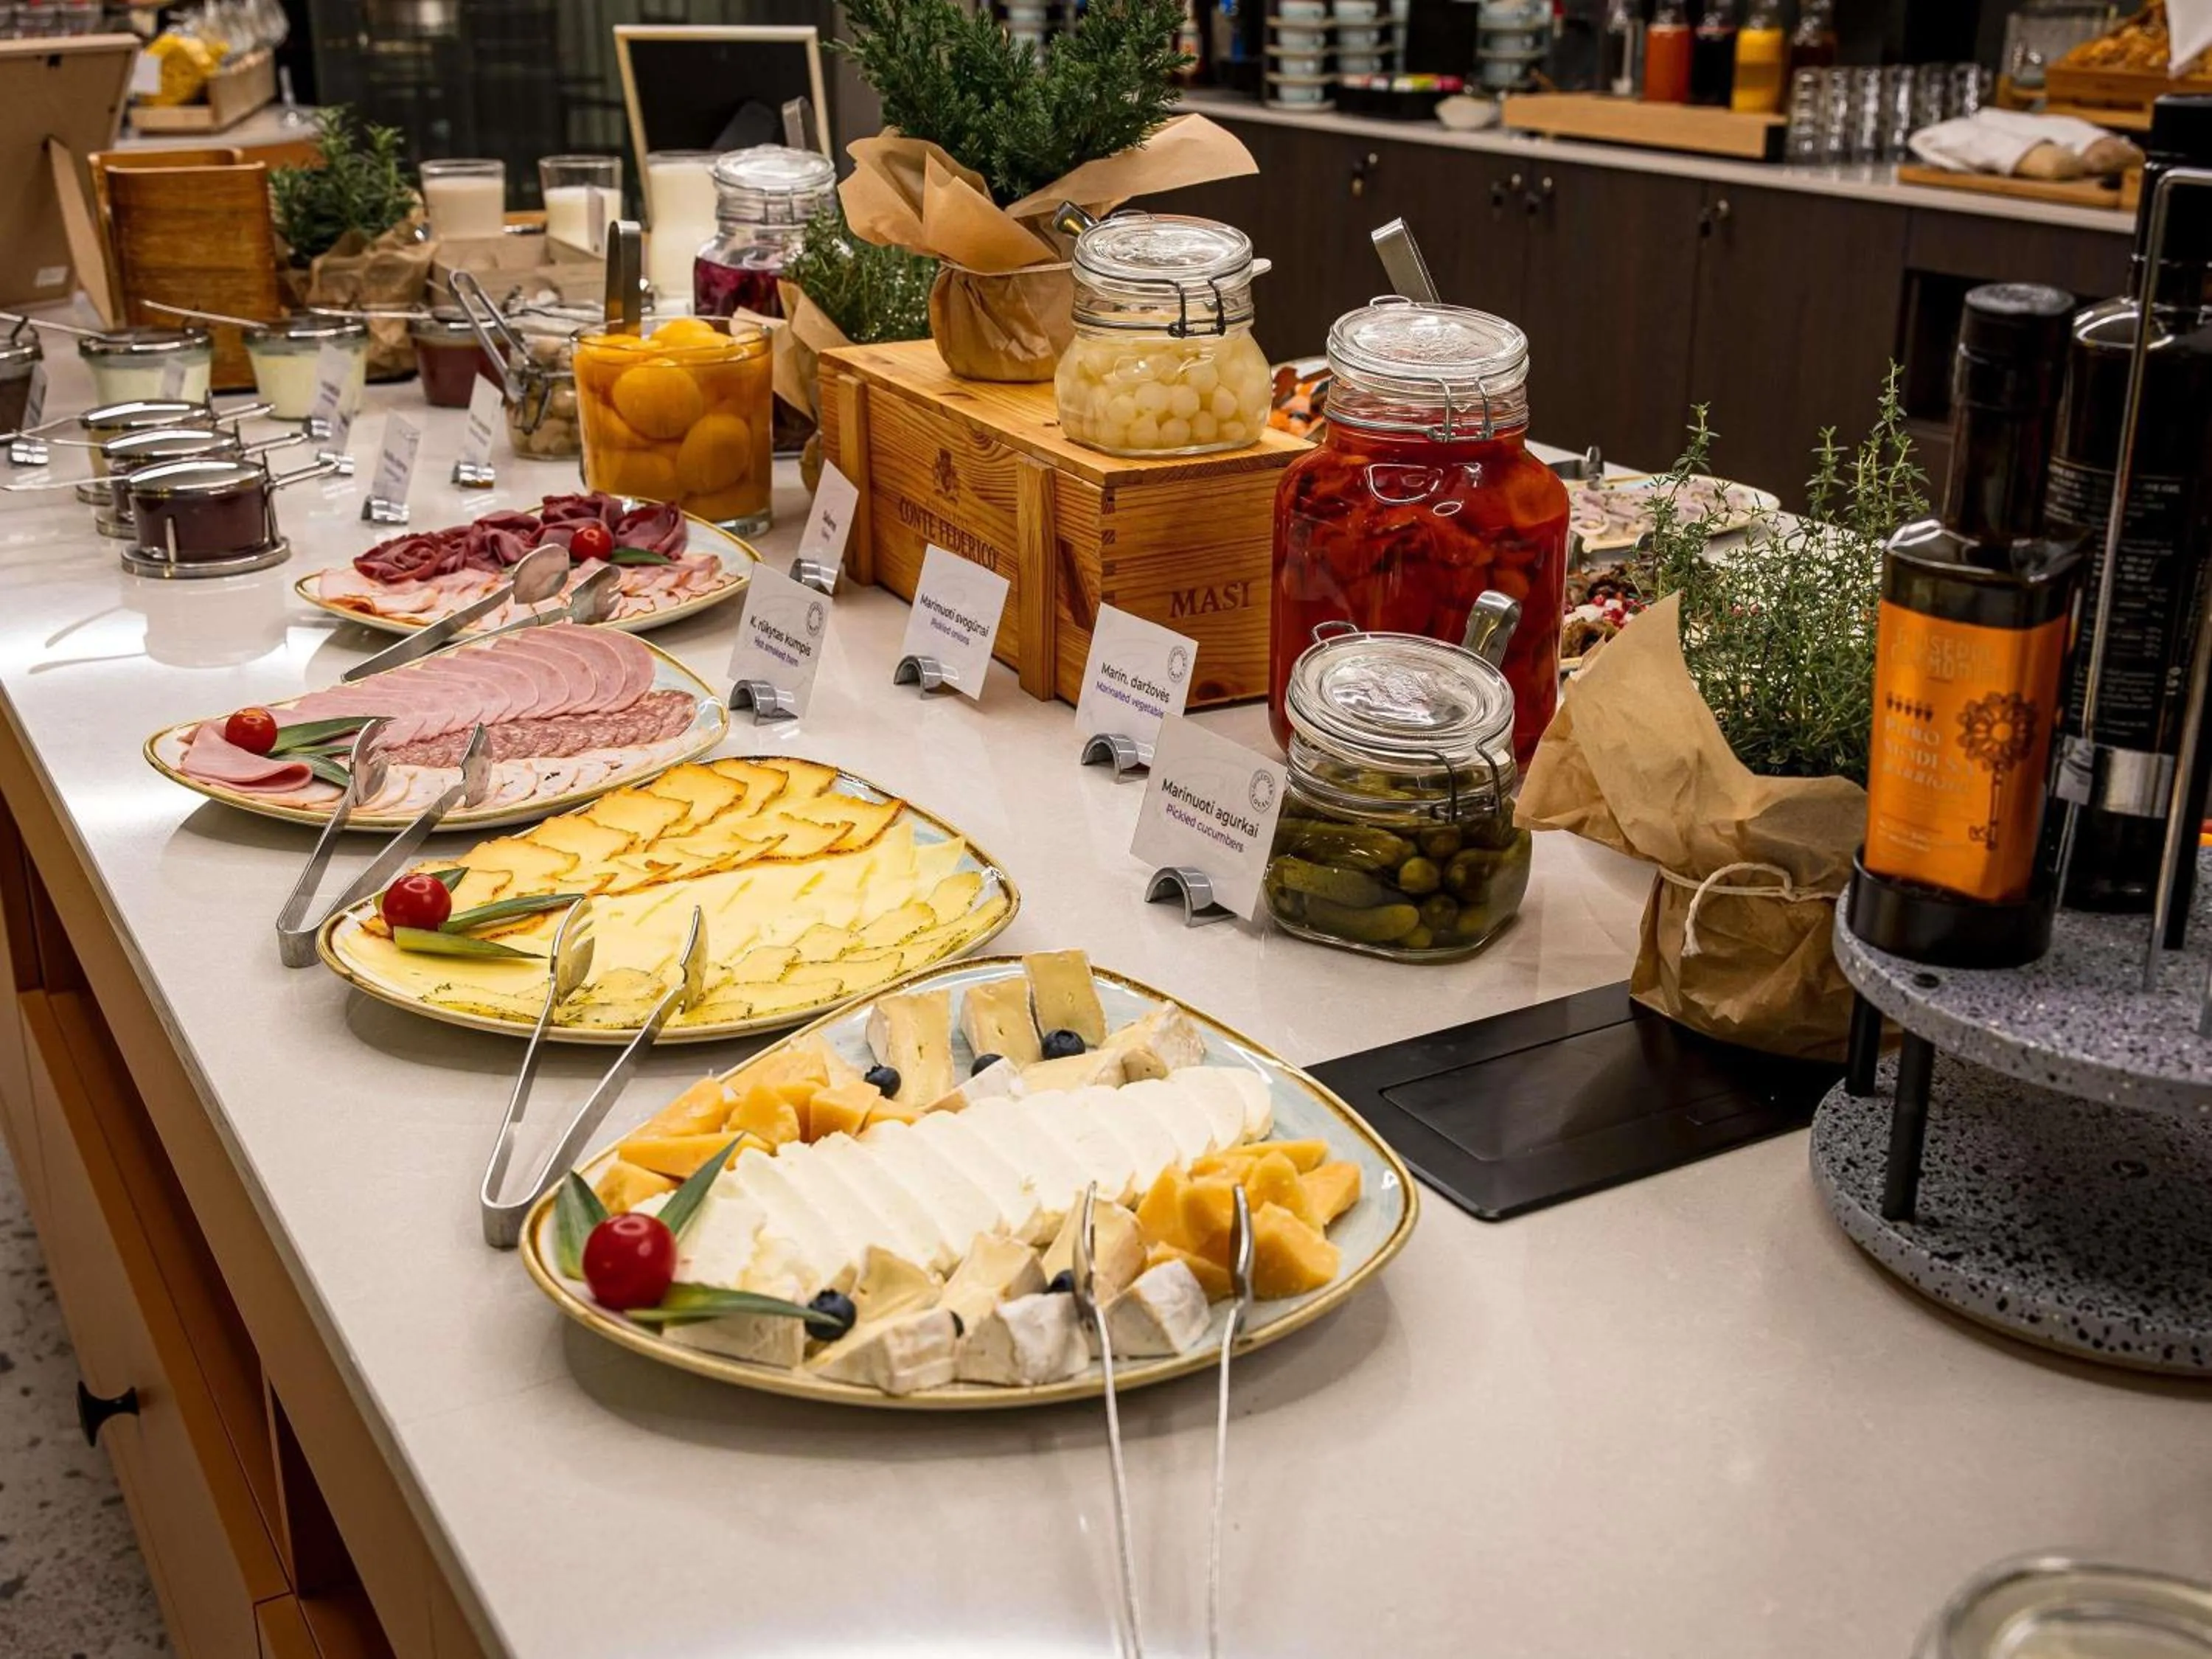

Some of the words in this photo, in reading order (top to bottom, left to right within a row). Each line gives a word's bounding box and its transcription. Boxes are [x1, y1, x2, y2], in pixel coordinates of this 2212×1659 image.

[899, 495, 936, 540] CONTE
[939, 518, 997, 571] FEDERICO
[920, 594, 956, 620] Marinuoti
[1169, 580, 1252, 619] MASI
[1096, 681, 1130, 704] Marinated
[1101, 662, 1129, 685] Marin.
[1130, 675, 1171, 703] daržovės
[1161, 778, 1217, 815] Marinuoti
[1216, 807, 1260, 838] agurkai
[1166, 803, 1197, 829] Pickled
[1197, 821, 1245, 853] cucumbers
